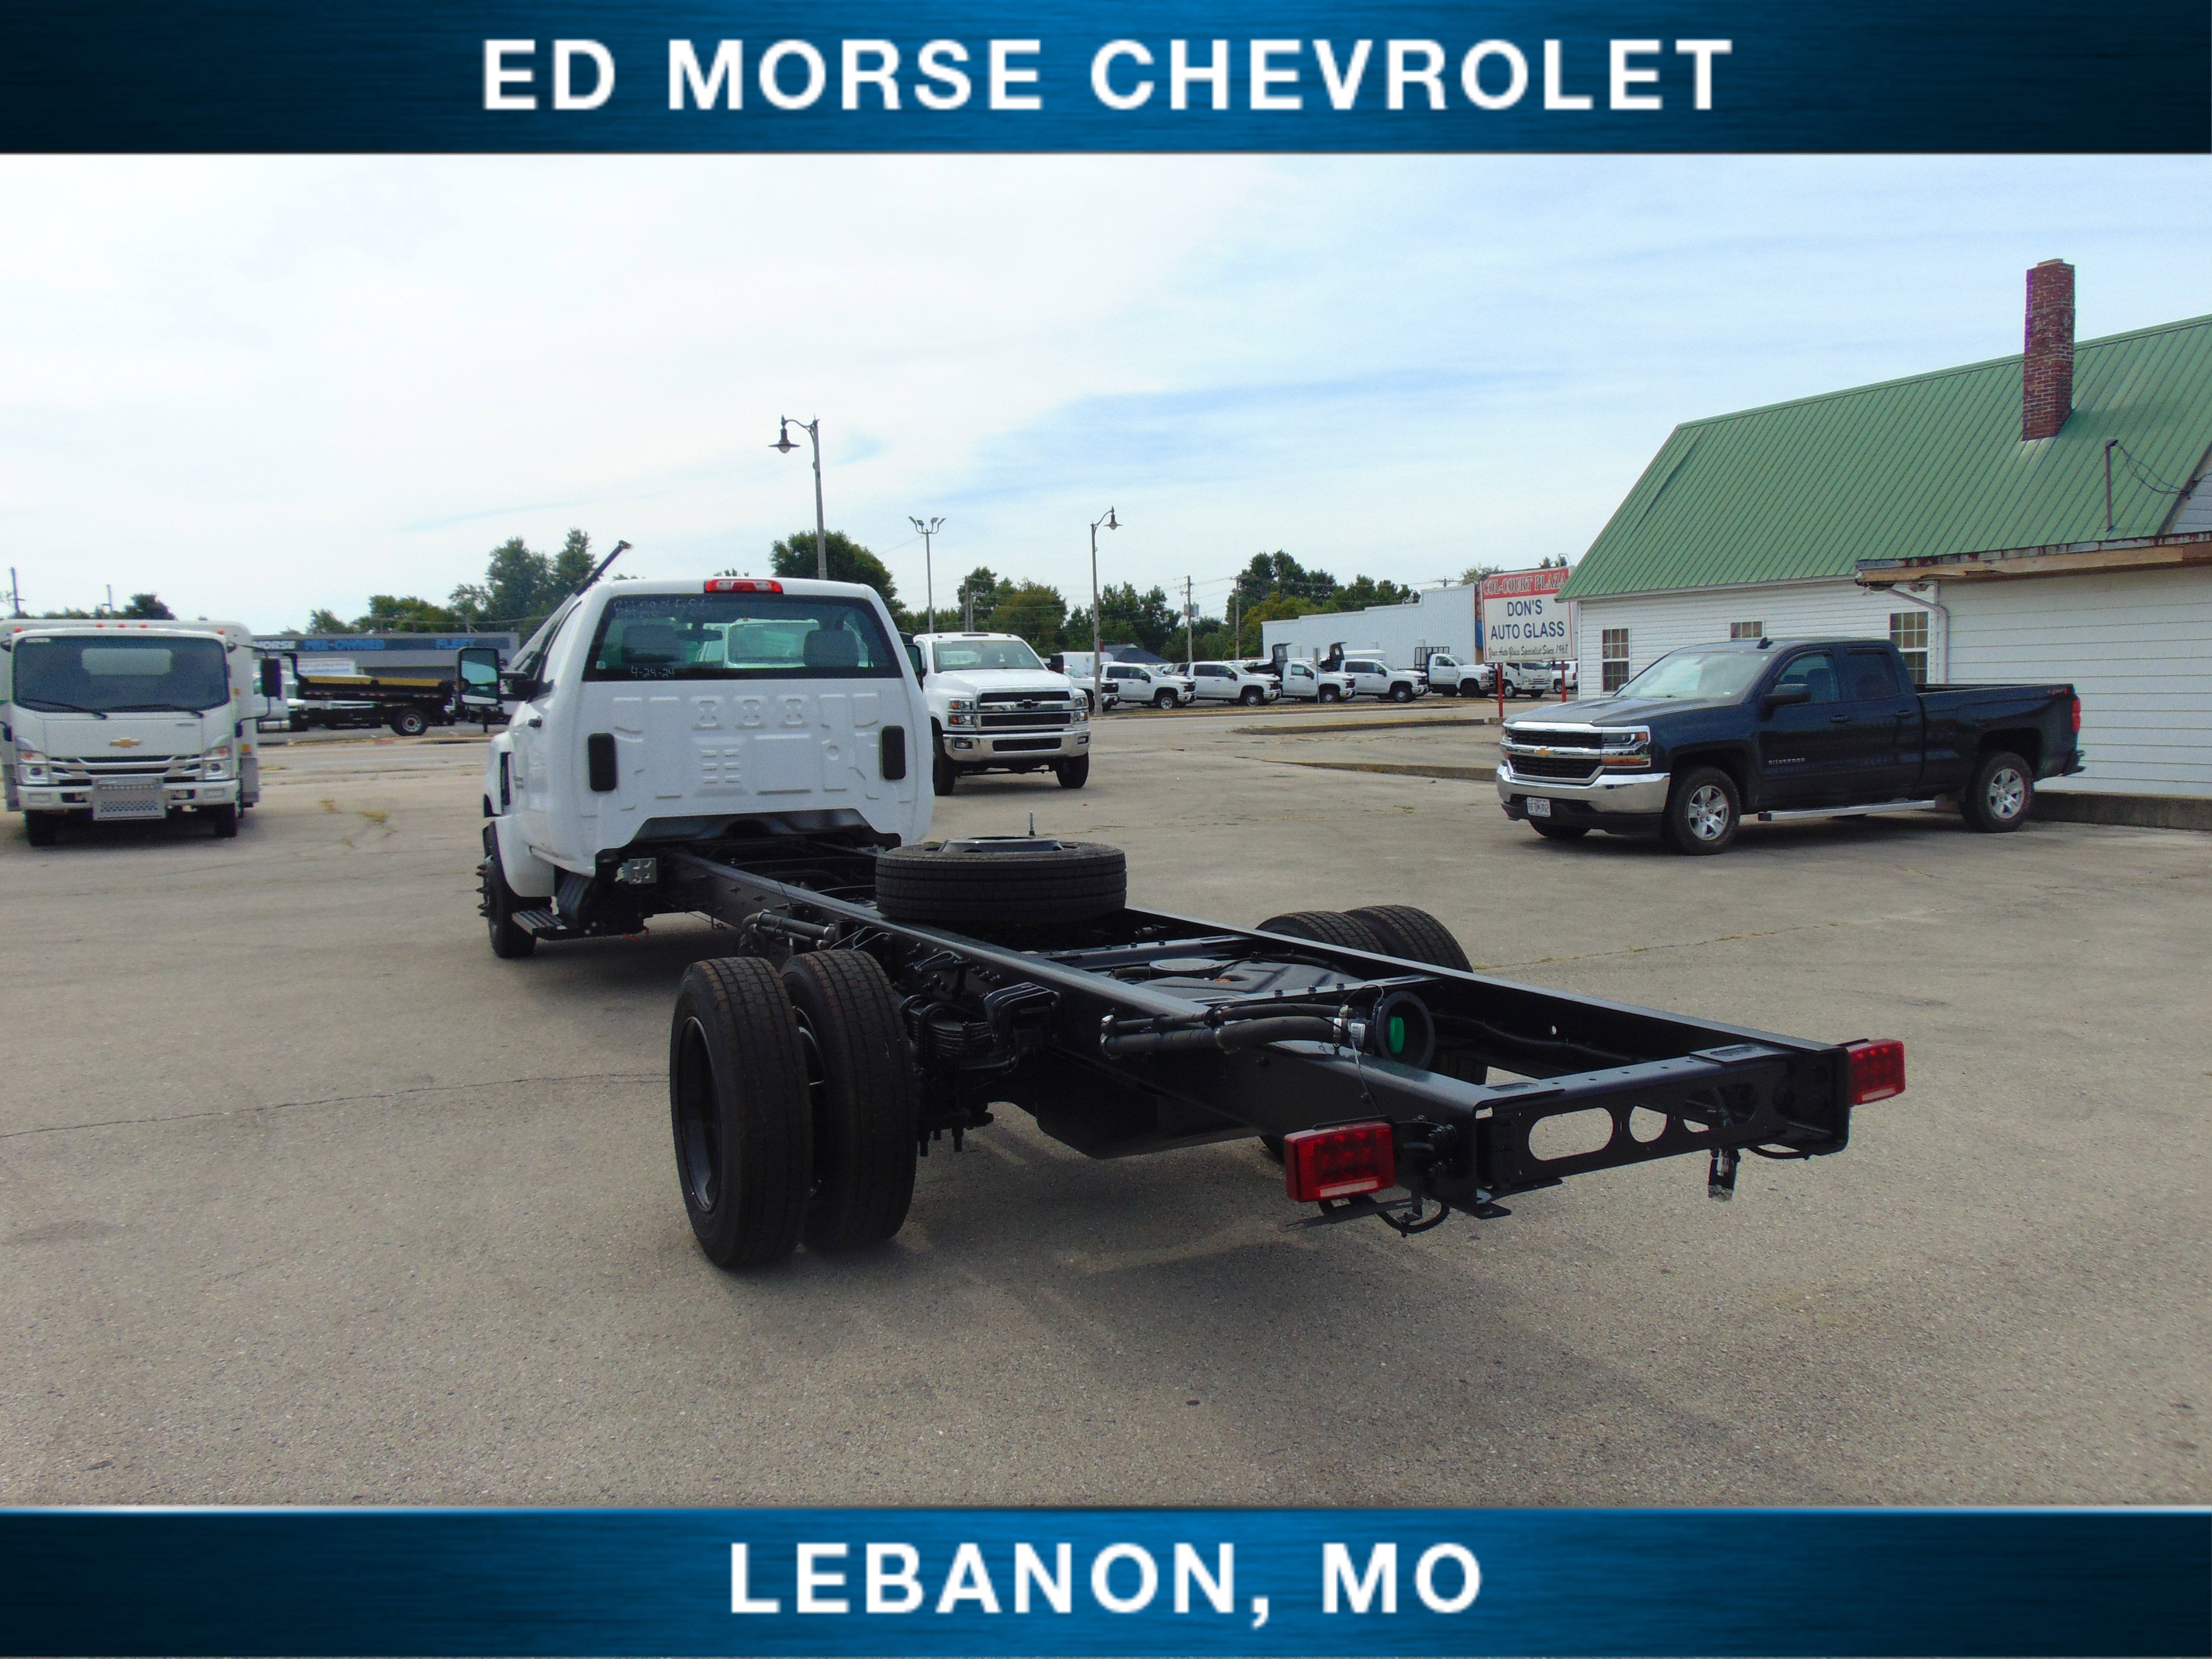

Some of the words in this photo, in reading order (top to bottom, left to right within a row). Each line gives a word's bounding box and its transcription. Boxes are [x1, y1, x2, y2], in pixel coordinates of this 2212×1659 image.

[1507, 599, 1543, 617] DON'S
[1491, 624, 1520, 640] AUTO
[1524, 621, 1565, 638] GLASS
